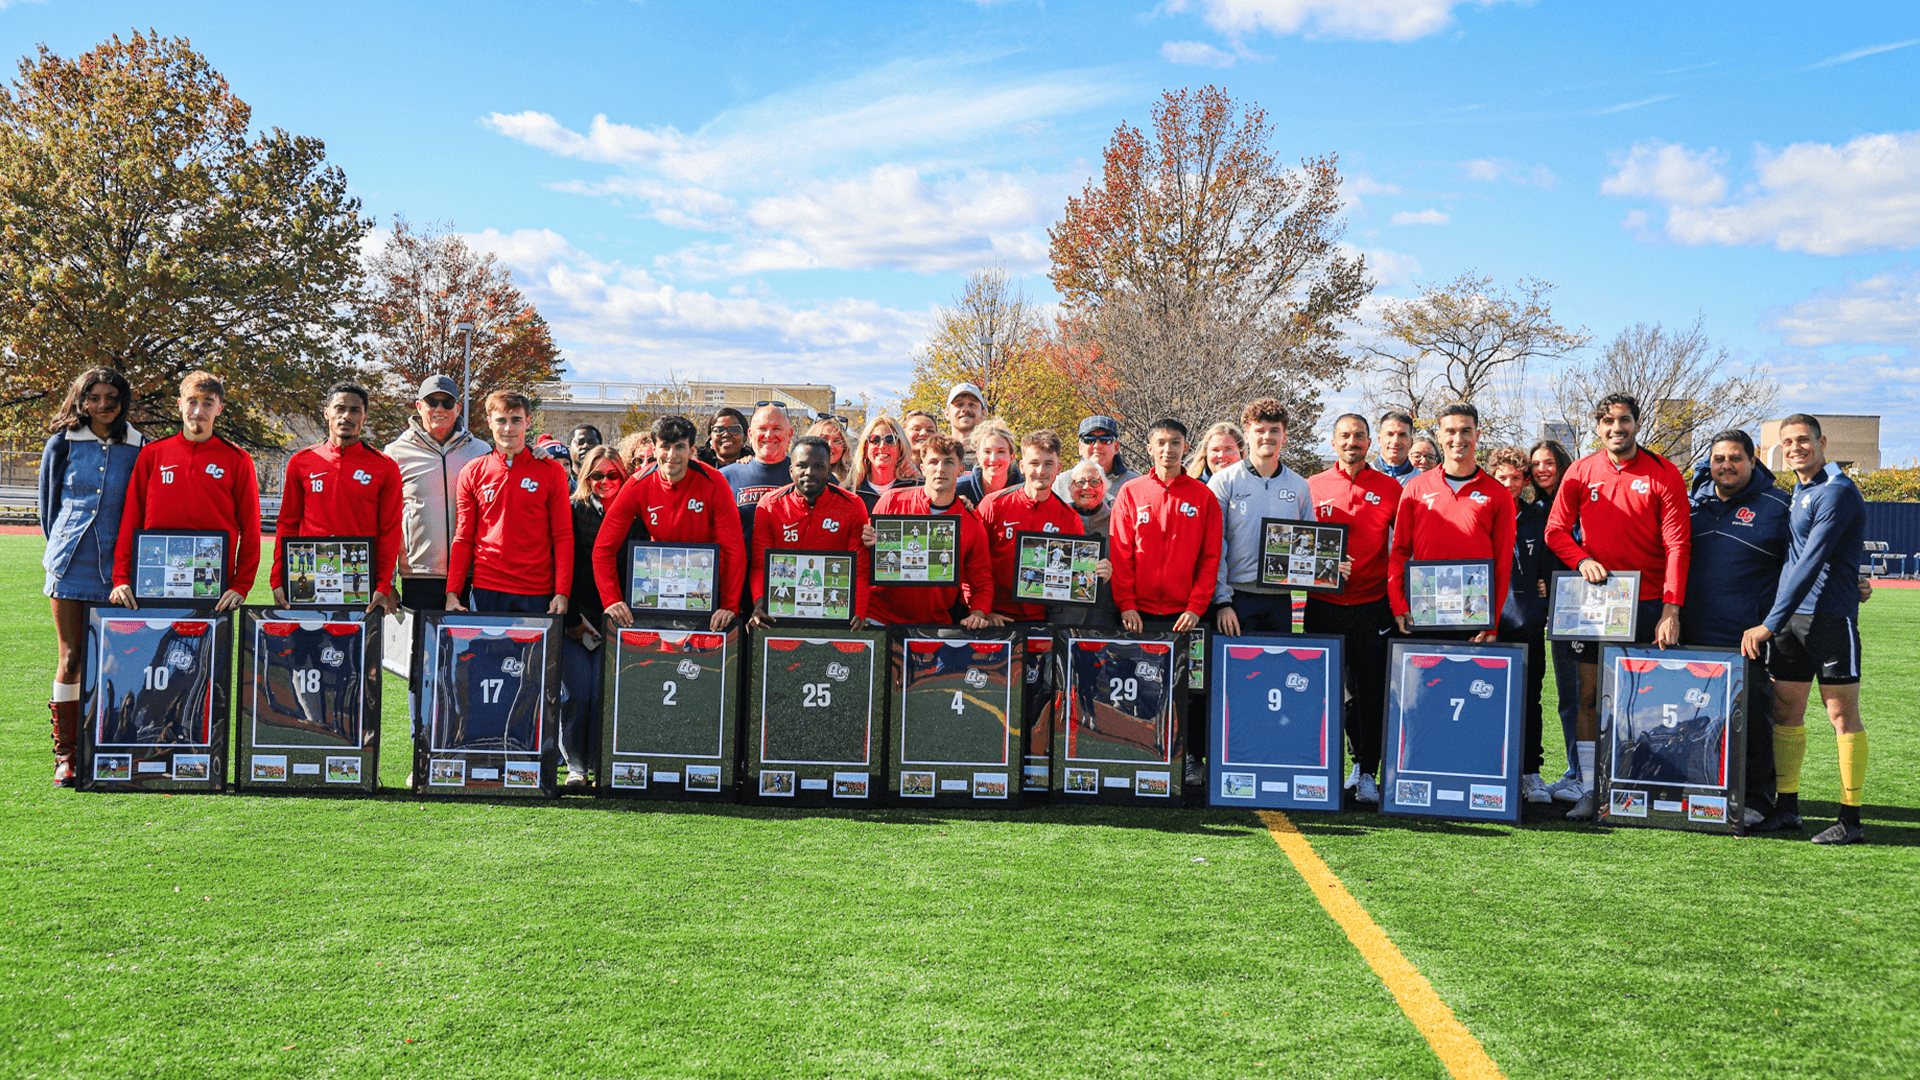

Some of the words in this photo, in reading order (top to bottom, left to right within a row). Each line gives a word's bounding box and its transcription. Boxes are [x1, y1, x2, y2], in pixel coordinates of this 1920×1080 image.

[161, 471, 174, 484] 10
[205, 463, 225, 480] QC
[352, 469, 373, 485] QC
[311, 480, 324, 493] 18
[520, 477, 539, 493] QC
[1630, 475, 1650, 494] QC
[484, 489, 495, 503] 17
[1277, 488, 1296, 503] QC
[1364, 490, 1381, 506] QC
[1426, 498, 1434, 510] 7
[1469, 490, 1488, 504] QC
[1590, 489, 1599, 502] 5
[687, 498, 704, 513] QC
[1179, 502, 1198, 517] QC
[1239, 501, 1248, 513] 9
[1320, 505, 1334, 518] FV
[650, 512, 658, 525] 2
[1137, 512, 1150, 524] 29
[1735, 507, 1756, 523] QC
[821, 518, 841, 533] QC
[1006, 527, 1014, 539] 6
[784, 530, 799, 543] 25
[1528, 544, 1534, 556] 7
[168, 650, 194, 670] QC
[321, 647, 345, 667] QC
[501, 657, 526, 678] QC
[677, 659, 701, 680] QC
[826, 662, 850, 682] QC
[1134, 661, 1158, 681] QC
[143, 666, 169, 691] 10
[298, 669, 321, 693] 18
[964, 668, 988, 689] QC
[1285, 672, 1309, 692] QC
[480, 679, 504, 704] 17
[662, 681, 677, 706] 2
[802, 683, 831, 708] 25
[1109, 677, 1138, 701] 29
[1469, 679, 1495, 699] QC
[951, 691, 965, 715] 4
[1268, 689, 1282, 712] 9
[1684, 688, 1711, 709] QC
[1450, 698, 1465, 722] 7
[1662, 704, 1678, 729] 5
